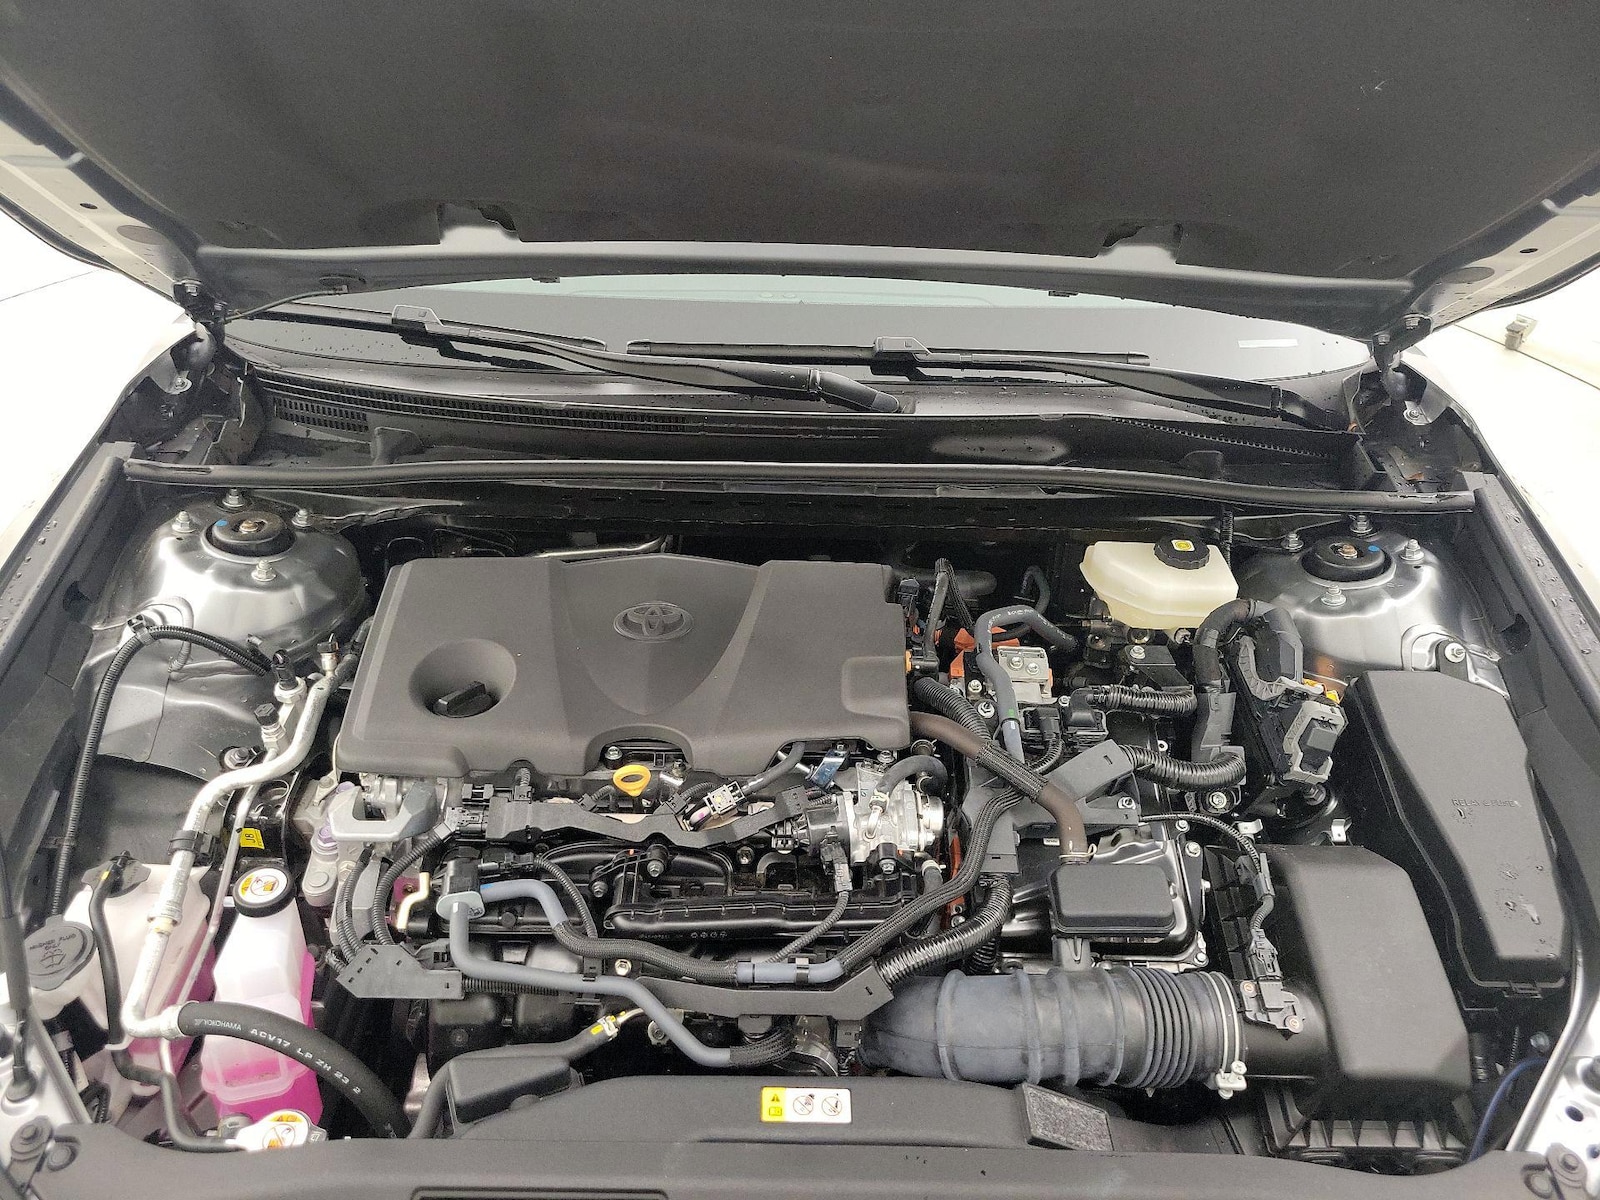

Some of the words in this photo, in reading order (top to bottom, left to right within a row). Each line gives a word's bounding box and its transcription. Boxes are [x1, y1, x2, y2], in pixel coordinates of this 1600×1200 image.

[201, 1019, 242, 1031] YOKOHAMA
[250, 1028, 291, 1048] ACV17
[297, 1048, 313, 1060] LP
[334, 1071, 350, 1084] 23
[352, 1086, 361, 1095] 2
